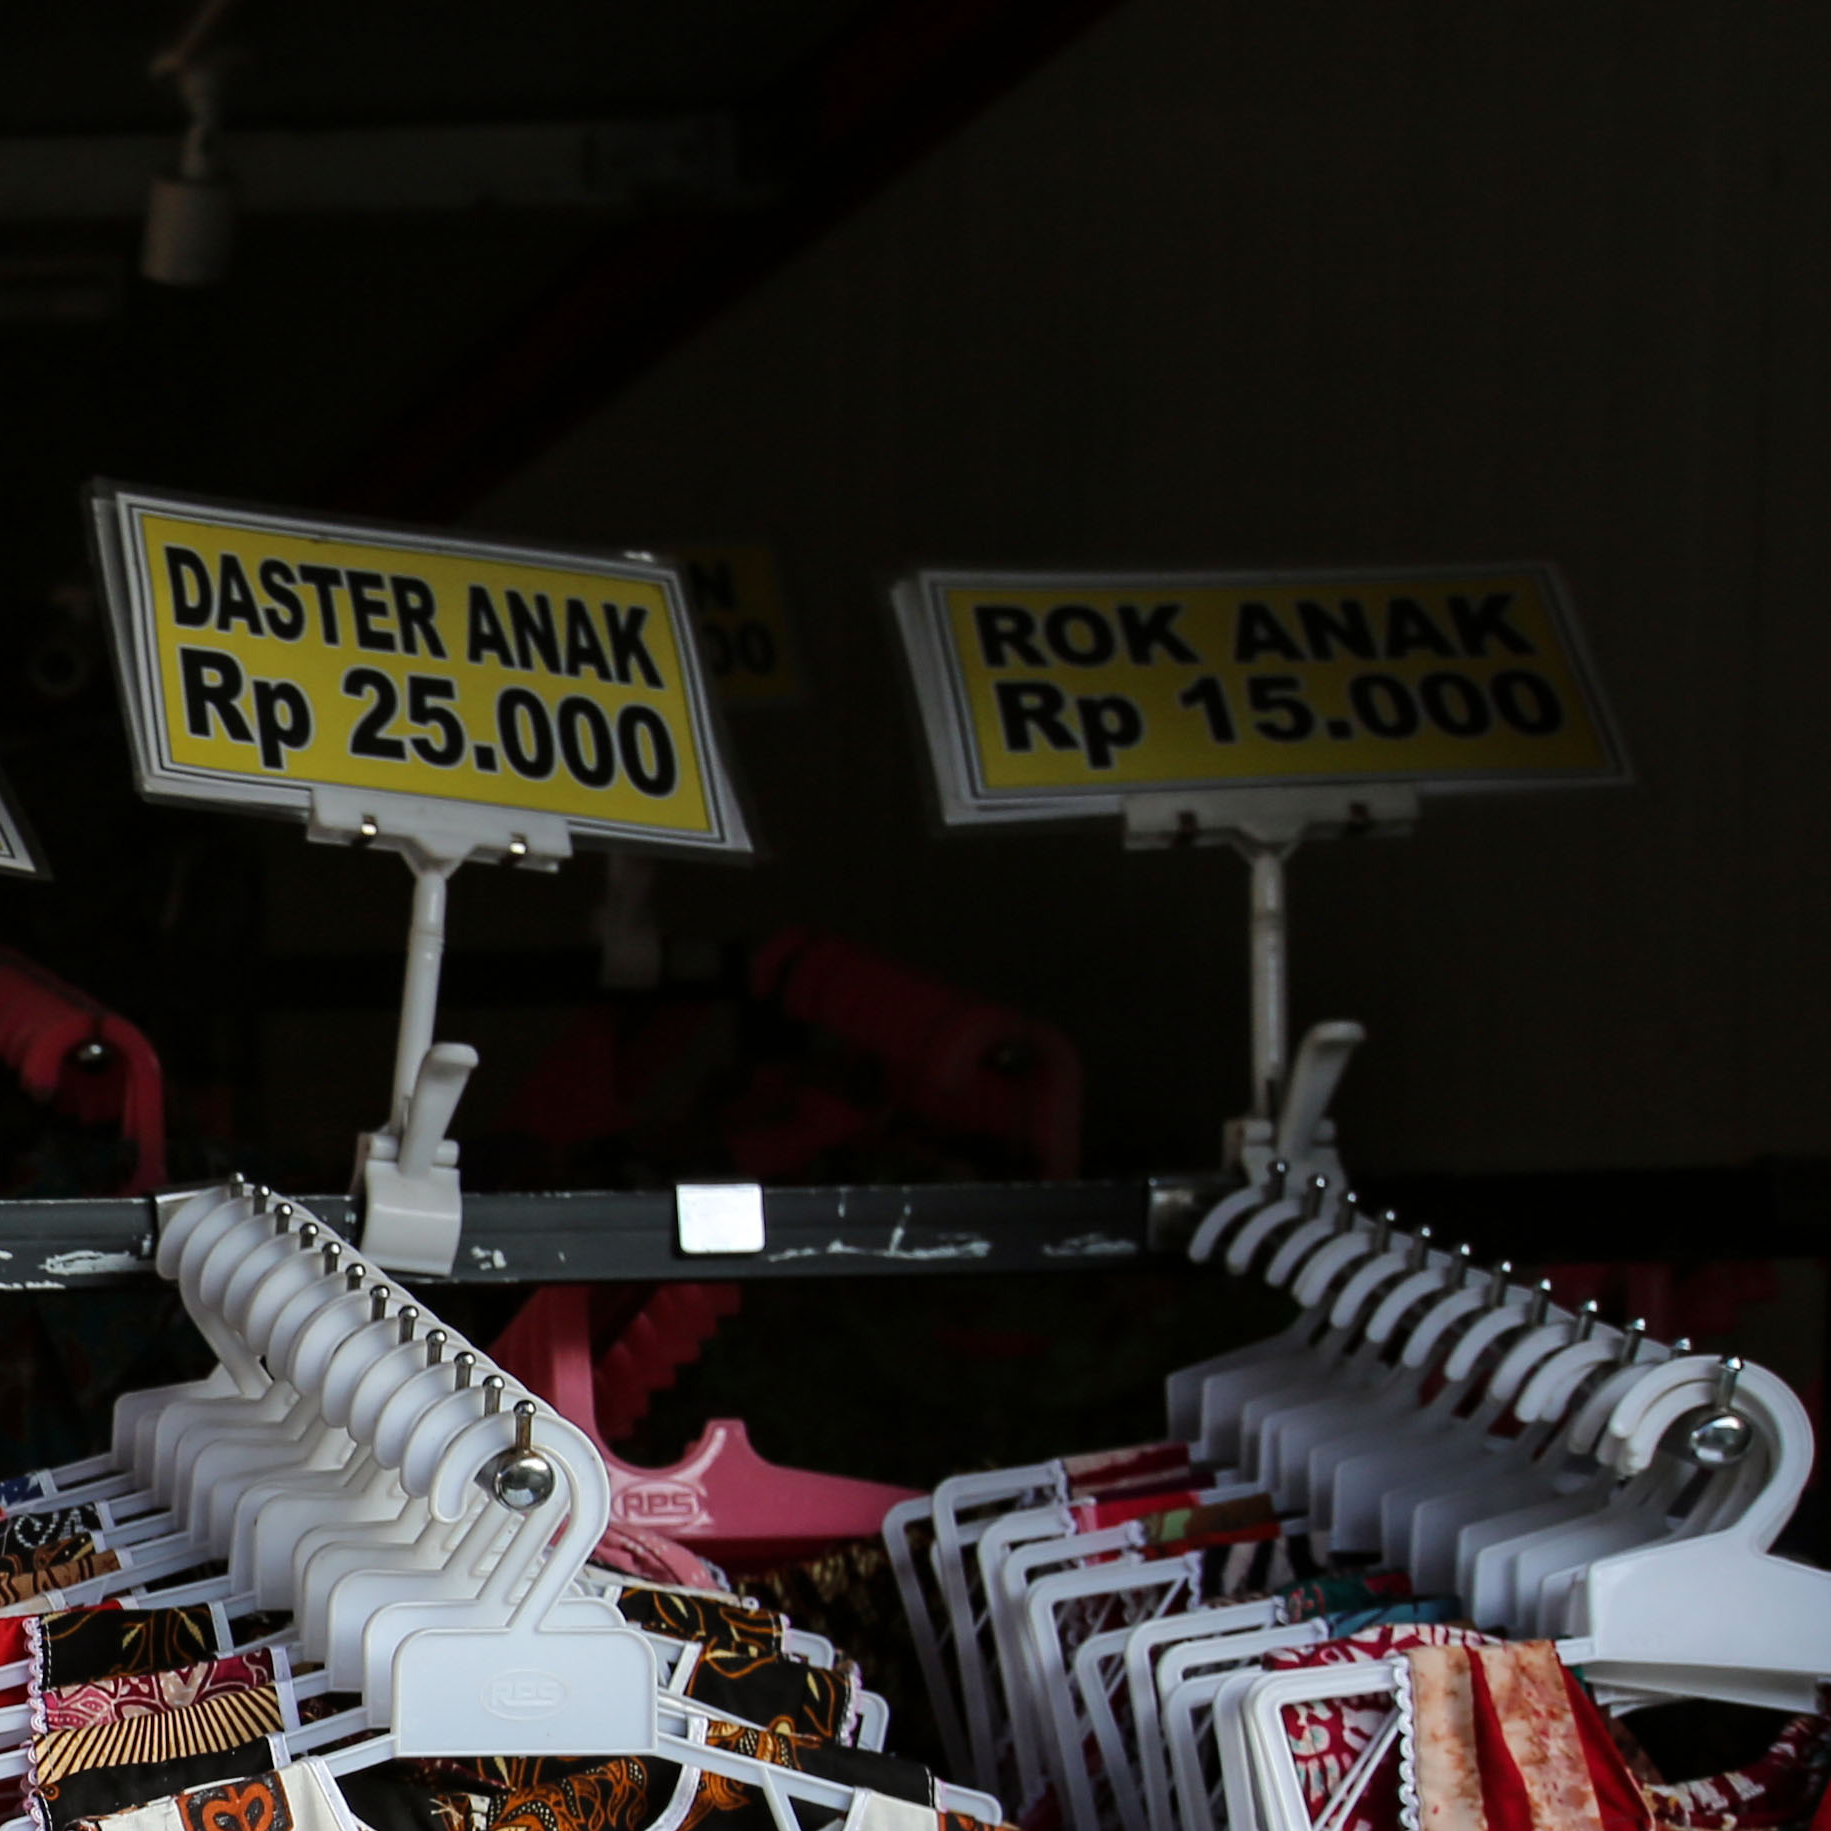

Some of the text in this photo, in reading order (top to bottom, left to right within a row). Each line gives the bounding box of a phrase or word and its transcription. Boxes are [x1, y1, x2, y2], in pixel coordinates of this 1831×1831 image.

[164, 545, 447, 660] DASTER
[468, 585, 665, 690] ANAK
[973, 594, 1534, 667] ROK ANAK
[180, 646, 678, 798] Rp 25.000
[995, 671, 1561, 768] Rp 15.000
[621, 1492, 694, 1518] RPS
